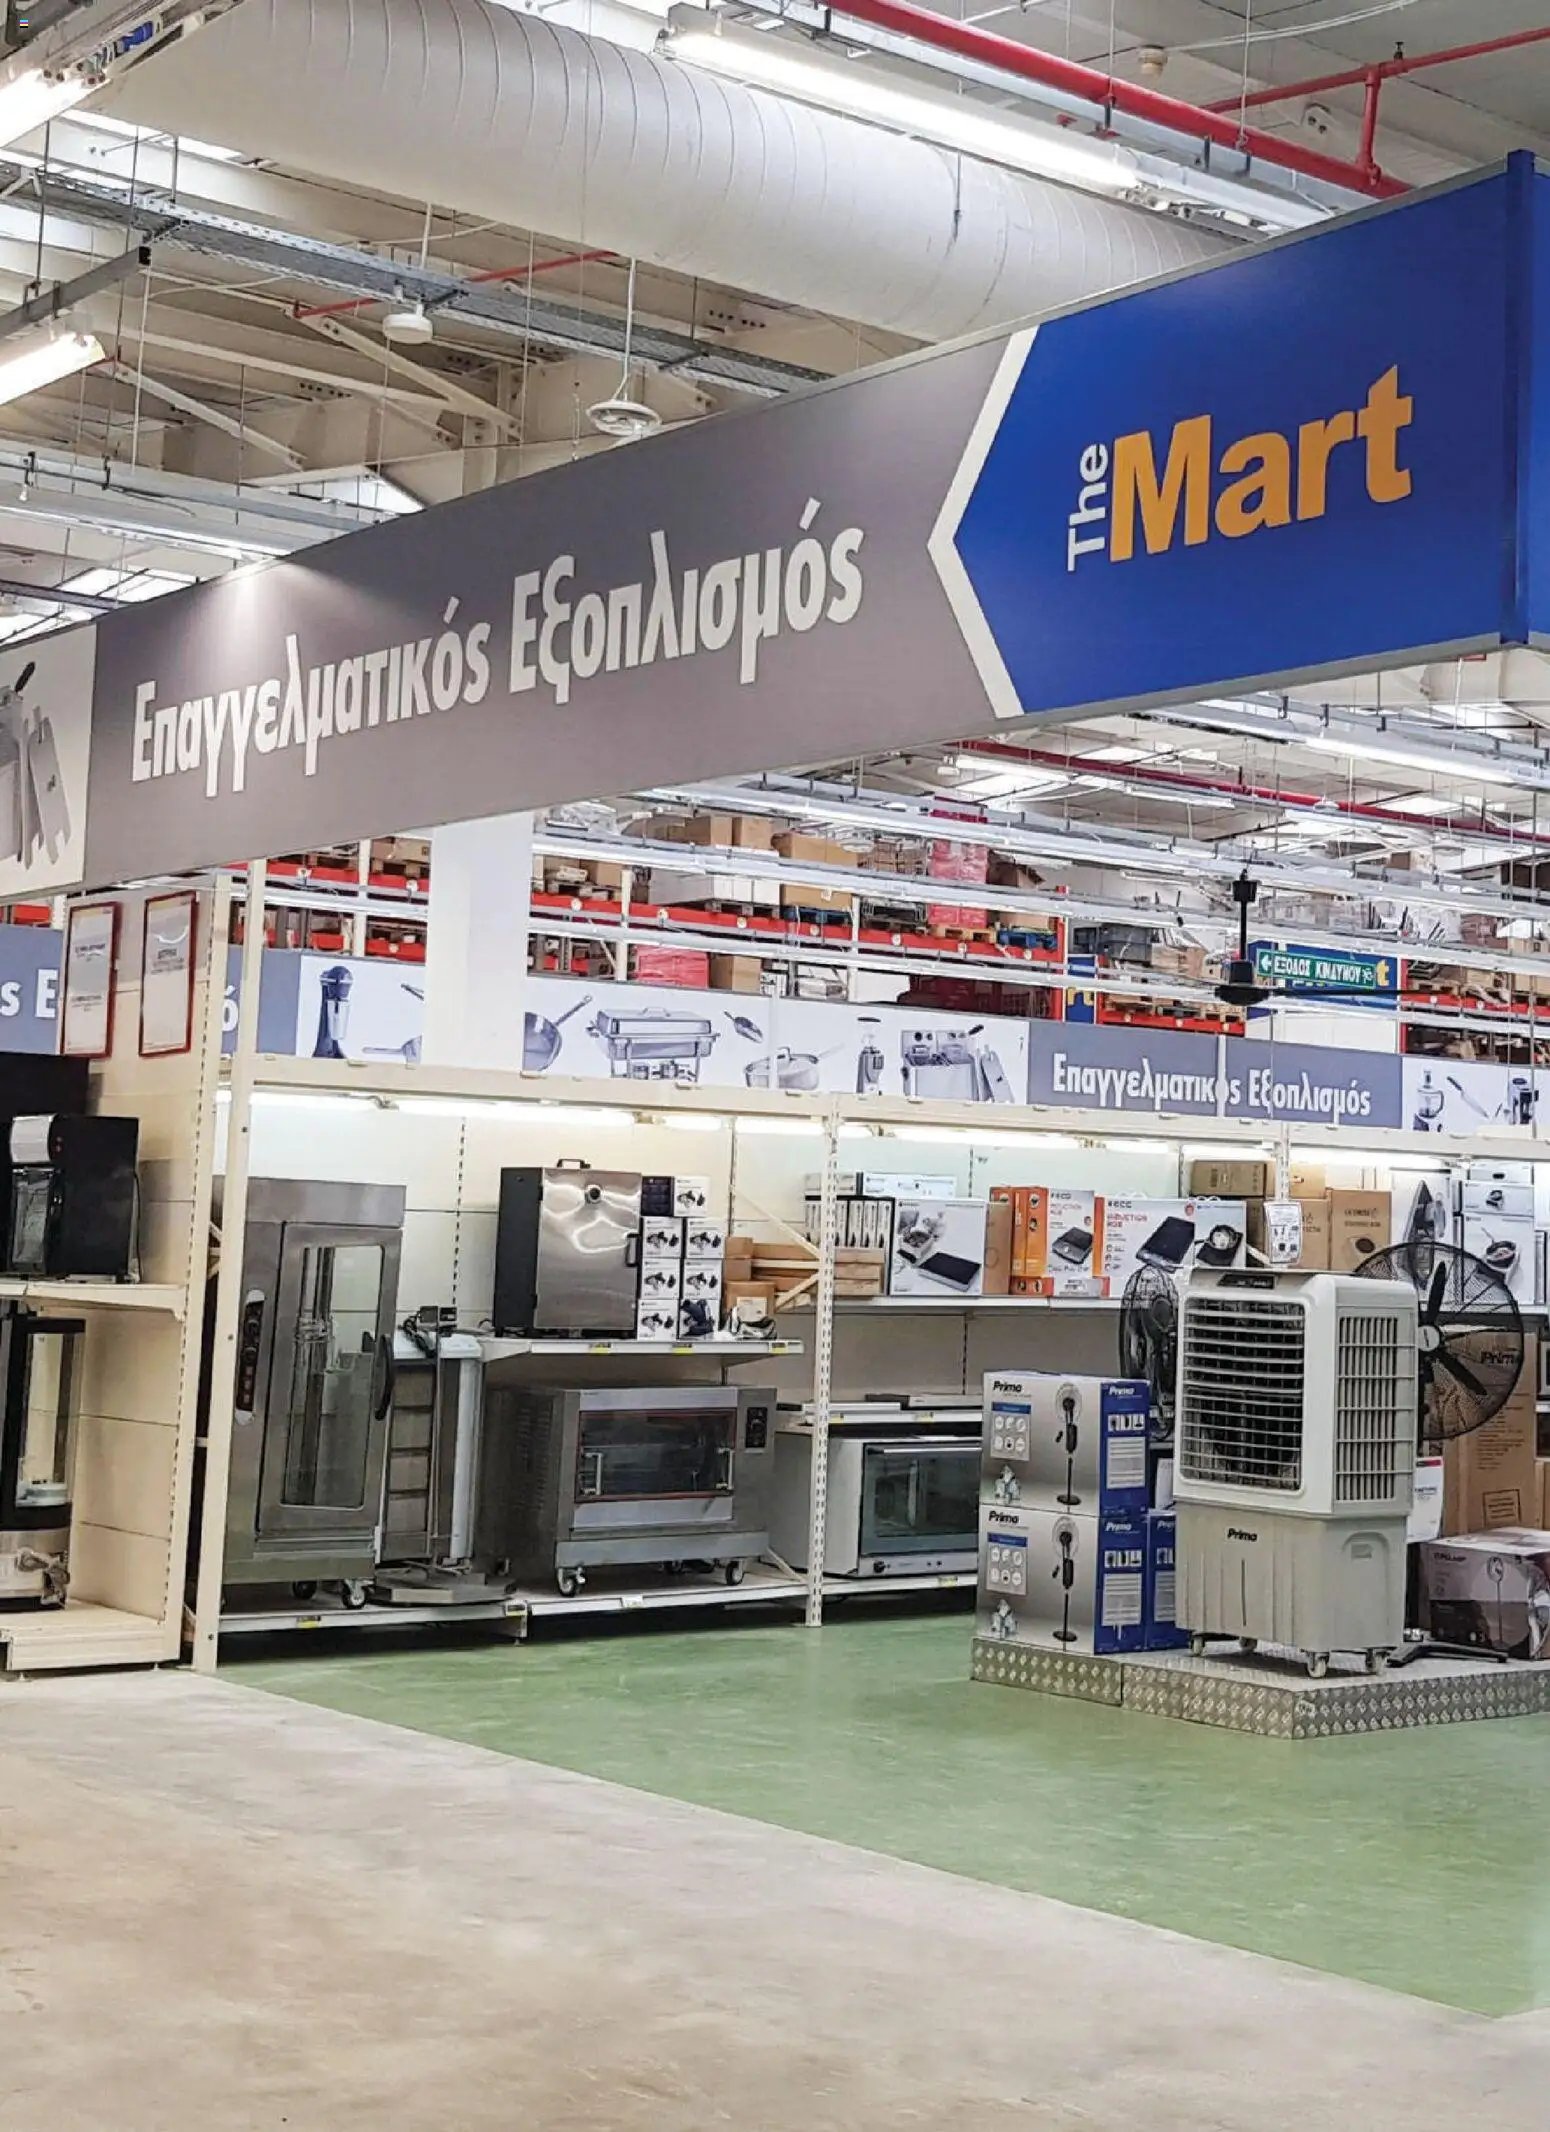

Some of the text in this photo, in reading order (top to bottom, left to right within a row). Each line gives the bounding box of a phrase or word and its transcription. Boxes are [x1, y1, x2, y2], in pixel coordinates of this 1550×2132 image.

[1109, 363, 1414, 563] Mart
[1067, 443, 1109, 573] The
[132, 497, 865, 798] Επαγγελματικός Εξοπλισμός
[1249, 1069, 1371, 1125] Εξοπλισμός
[993, 1380, 1022, 1393] Primo
[988, 1510, 1019, 1524] Primo
[1227, 1527, 1258, 1542] Primo
